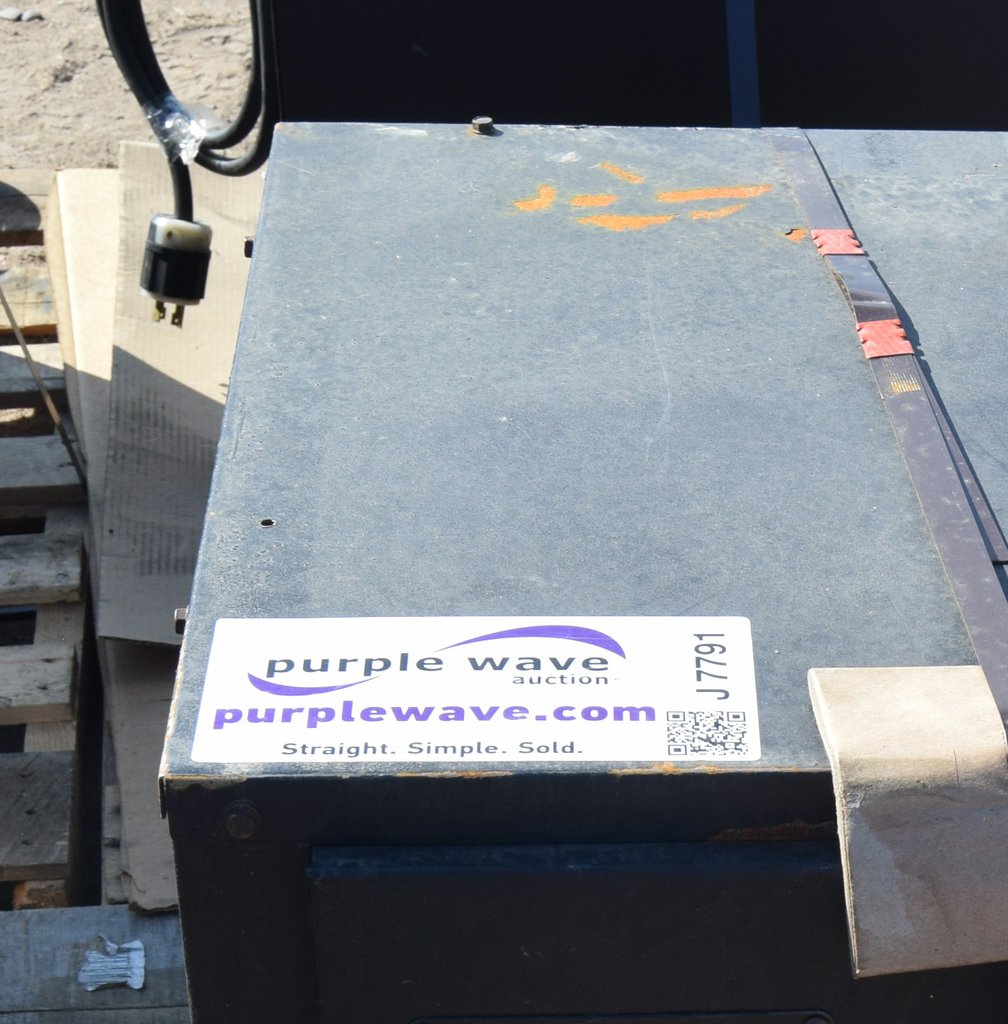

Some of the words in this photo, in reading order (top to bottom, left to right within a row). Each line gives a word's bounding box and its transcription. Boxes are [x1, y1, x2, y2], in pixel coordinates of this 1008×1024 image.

[265, 652, 444, 678] purple
[468, 654, 609, 672] wave
[693, 632, 727, 701] J7791
[512, 674, 608, 685] auction
[212, 700, 657, 730] purplewave.com
[281, 741, 397, 759] Straight.
[407, 740, 507, 758] Simple.
[517, 740, 583, 756] Sold.
